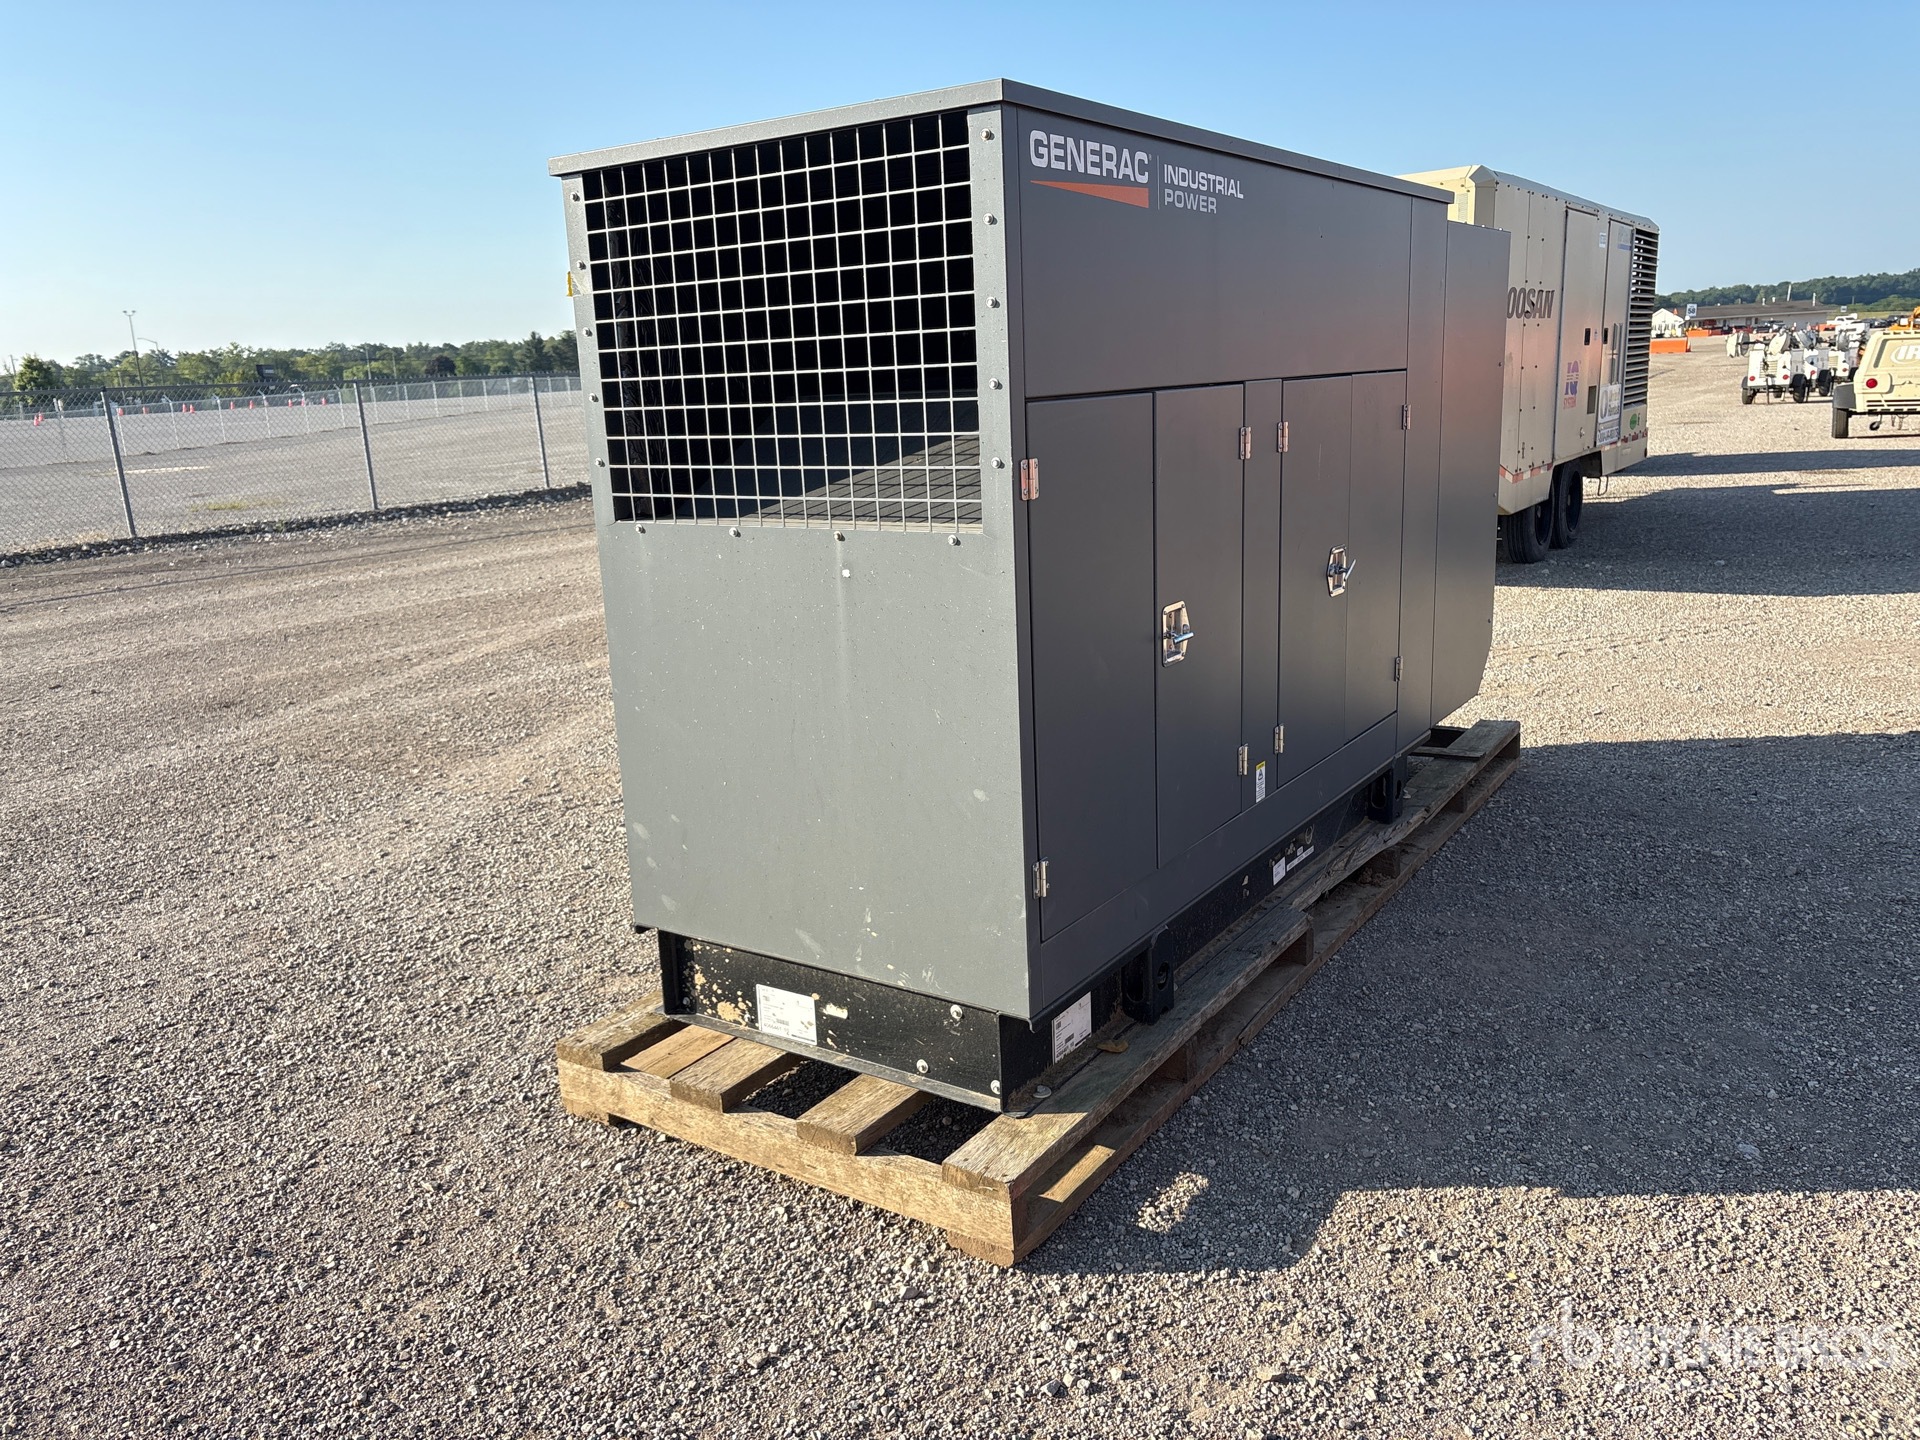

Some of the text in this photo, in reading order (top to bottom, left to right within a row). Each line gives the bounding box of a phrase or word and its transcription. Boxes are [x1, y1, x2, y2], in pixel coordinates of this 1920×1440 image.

[1029, 129, 1149, 184] GENERAC
[1163, 163, 1244, 200] INDUSTRIAL
[1163, 188, 1218, 214] POWER
[1506, 286, 1555, 320] OOSAN
[1896, 344, 1920, 360] IR
